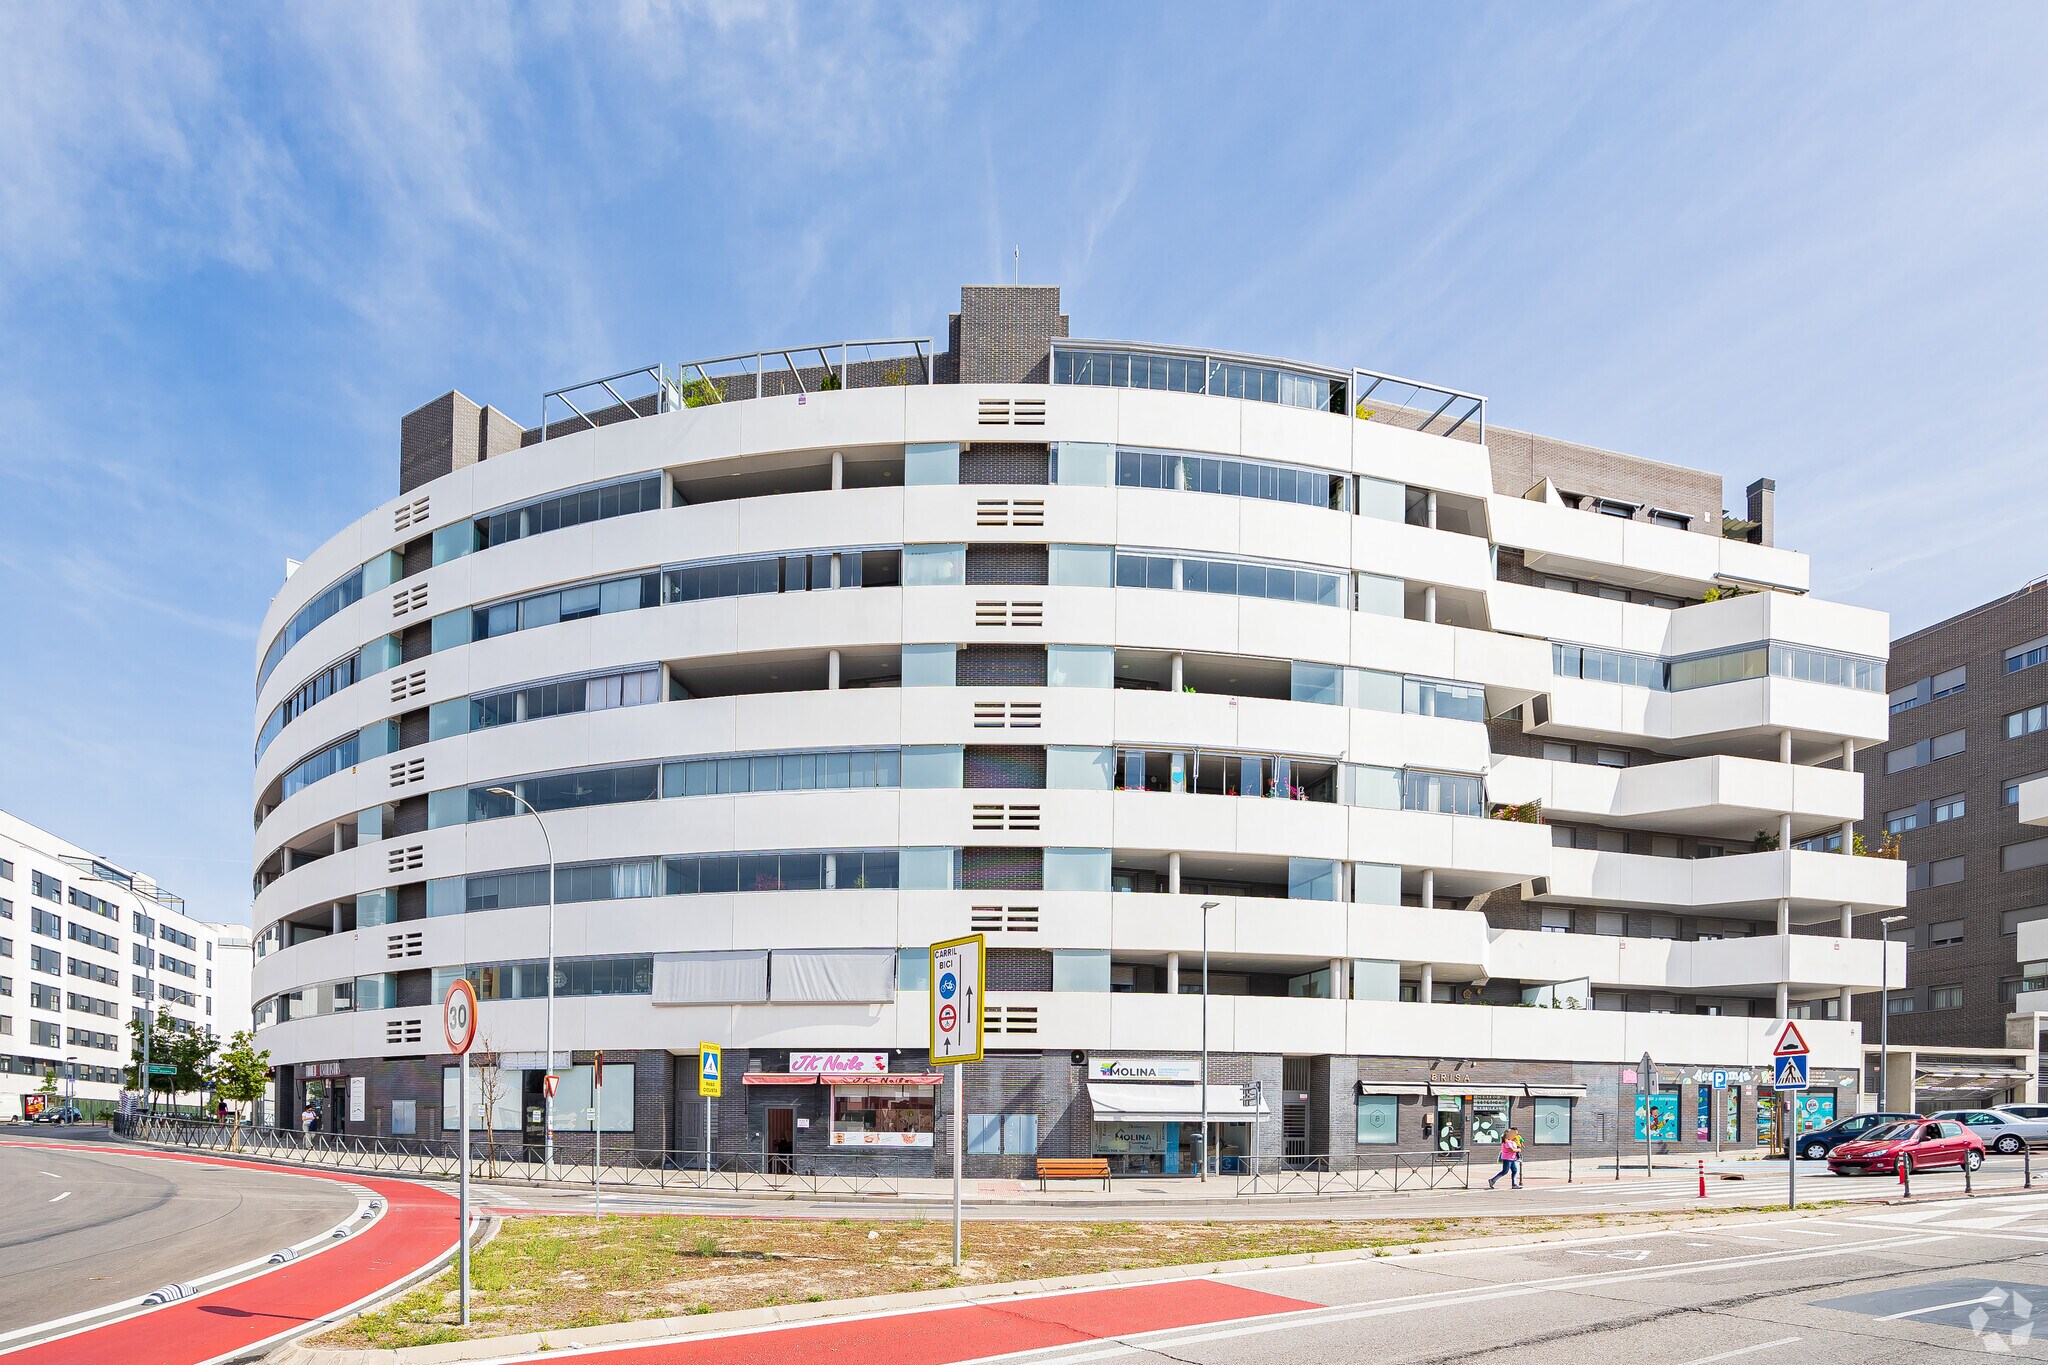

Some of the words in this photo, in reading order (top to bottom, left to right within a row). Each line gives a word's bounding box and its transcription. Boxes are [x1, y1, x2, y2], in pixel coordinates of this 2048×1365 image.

[935, 948, 957, 959] CARRIL
[939, 960, 953, 969] BICI
[449, 1004, 467, 1030] 30
[791, 1055, 823, 1071] JK
[822, 1054, 864, 1071] Nails
[1110, 1067, 1157, 1077] MOLINA
[1431, 1073, 1471, 1083] BRISA
[1692, 1068, 1752, 1086] Acamia
[1715, 1072, 1725, 1087] P
